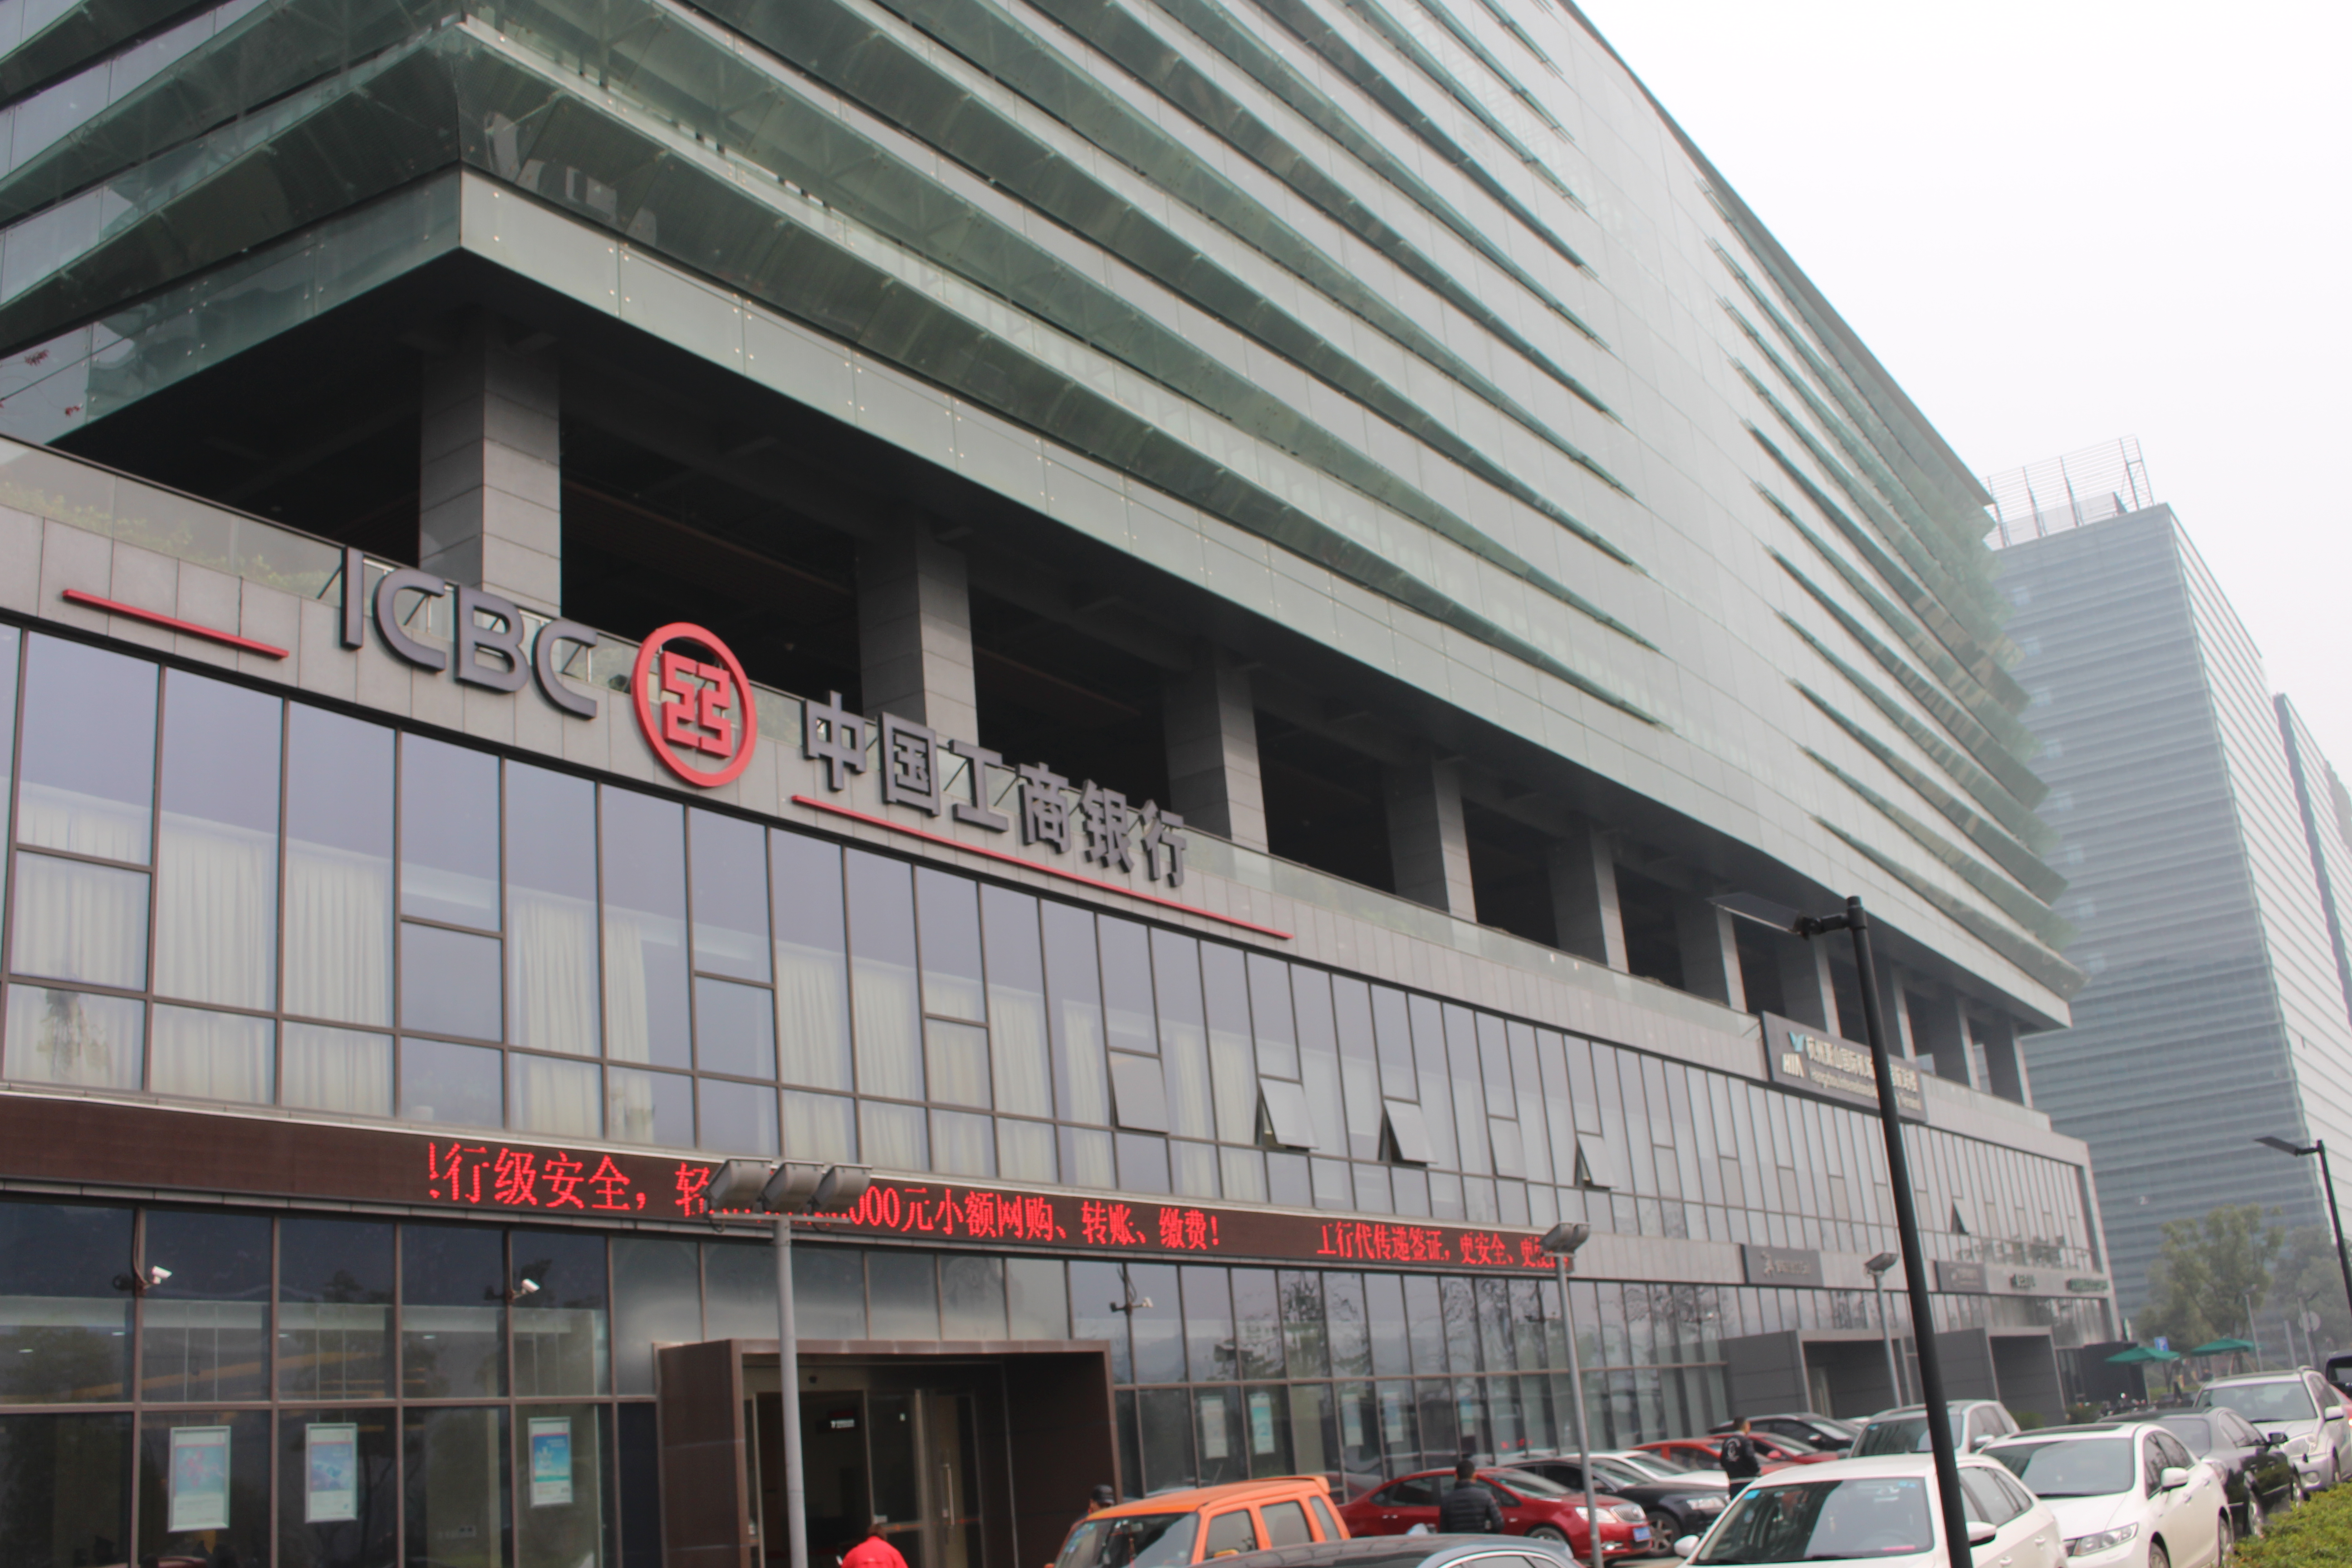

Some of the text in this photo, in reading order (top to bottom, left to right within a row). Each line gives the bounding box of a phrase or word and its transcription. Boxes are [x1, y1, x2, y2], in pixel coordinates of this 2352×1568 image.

[340, 545, 597, 720] ICBC
[802, 690, 1186, 887] 中国工商银行
